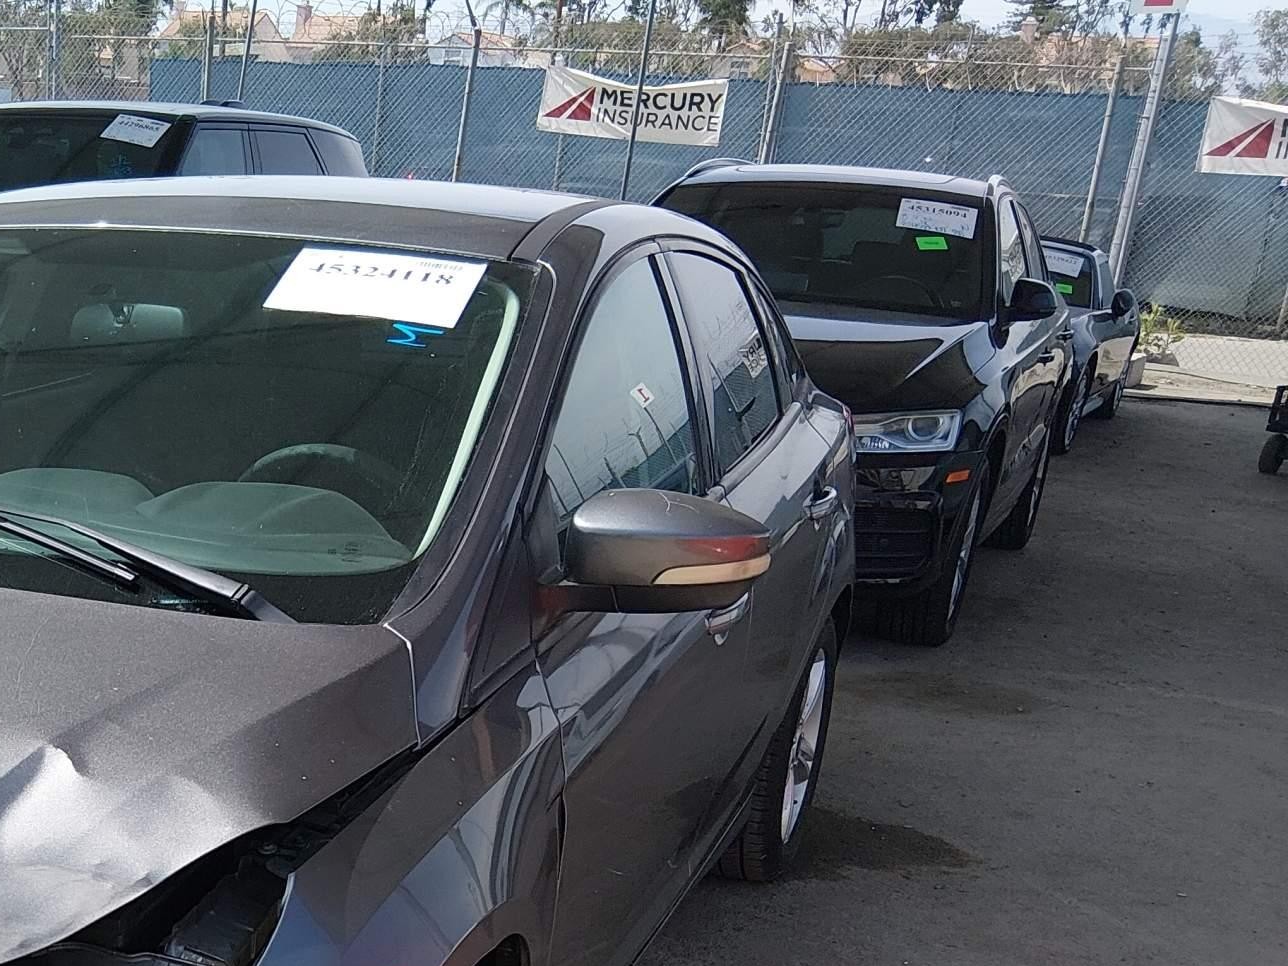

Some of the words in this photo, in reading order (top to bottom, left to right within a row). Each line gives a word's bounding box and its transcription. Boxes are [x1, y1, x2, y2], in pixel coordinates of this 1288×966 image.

[600, 87, 723, 113] MERCURY
[596, 107, 720, 132] INSURANCE
[309, 262, 454, 285] 45324118
